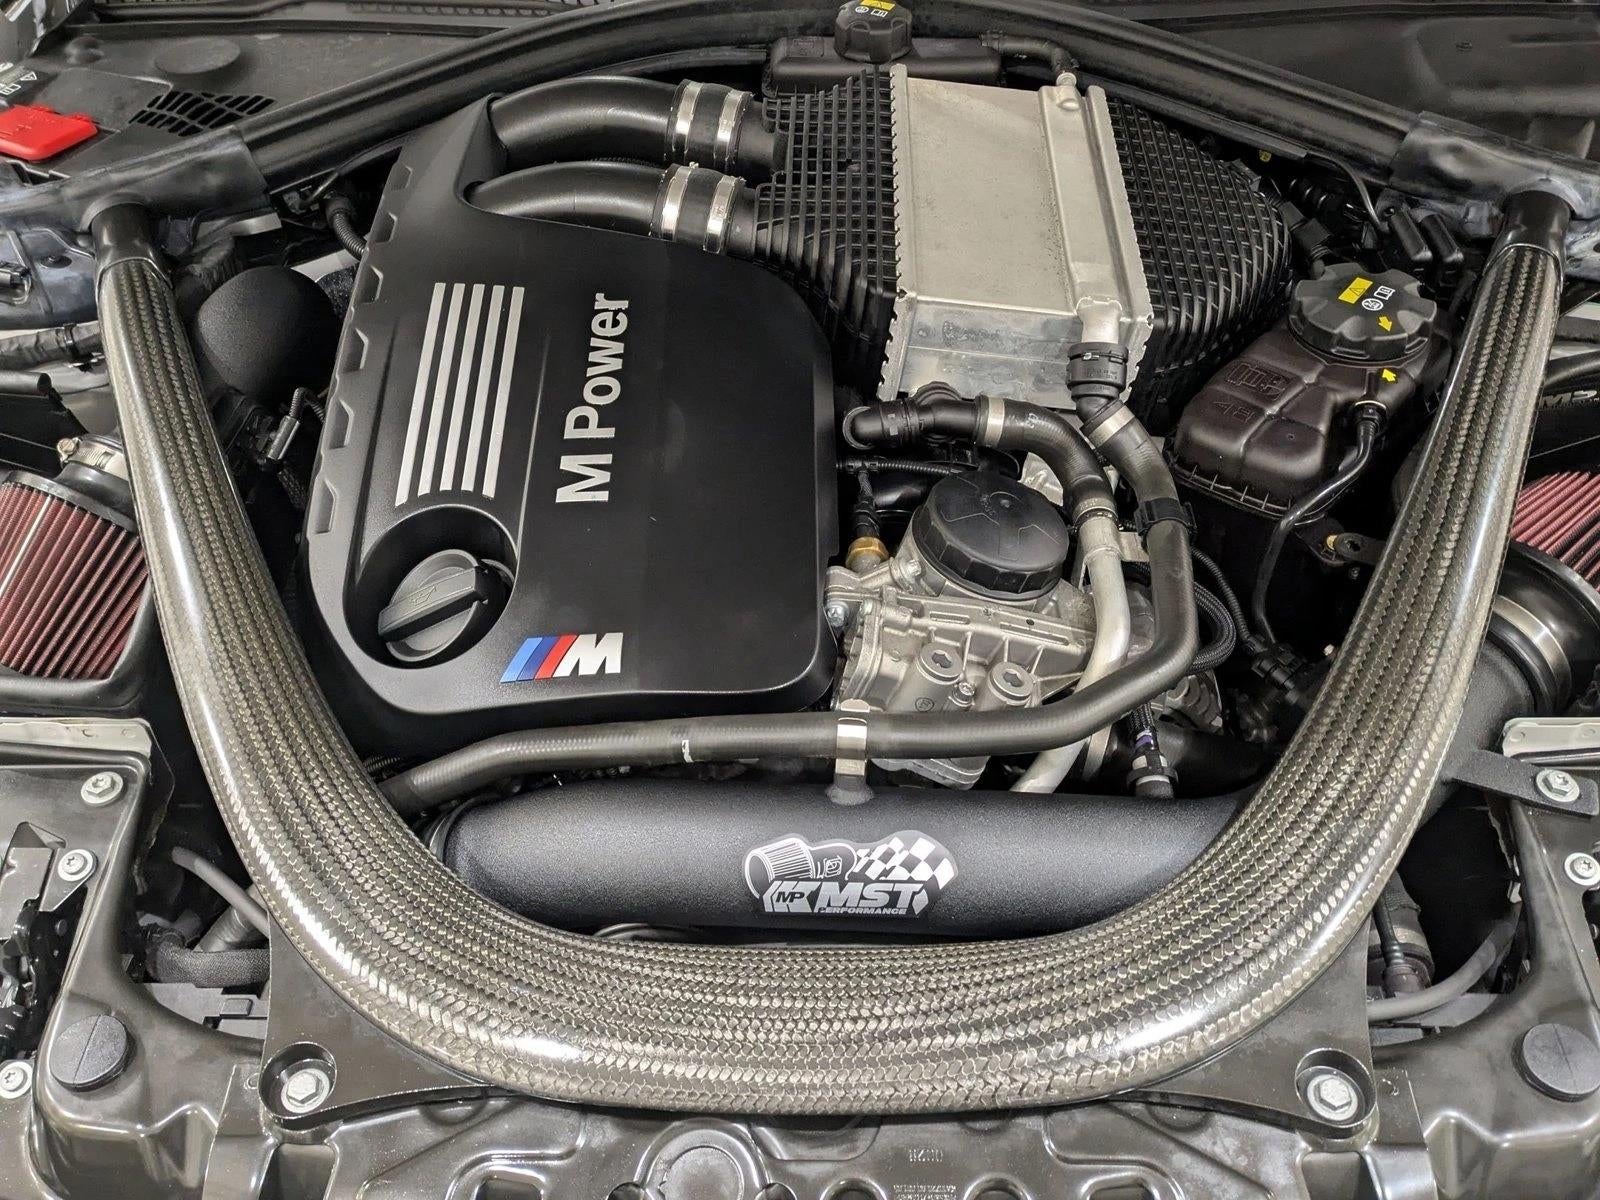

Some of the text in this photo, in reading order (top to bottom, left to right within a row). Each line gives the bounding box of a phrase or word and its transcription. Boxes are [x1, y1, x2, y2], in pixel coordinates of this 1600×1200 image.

[555, 292, 629, 503] M Power
[552, 632, 624, 678] M
[815, 881, 923, 909] MST
[819, 906, 907, 915] PERFORMANCE
